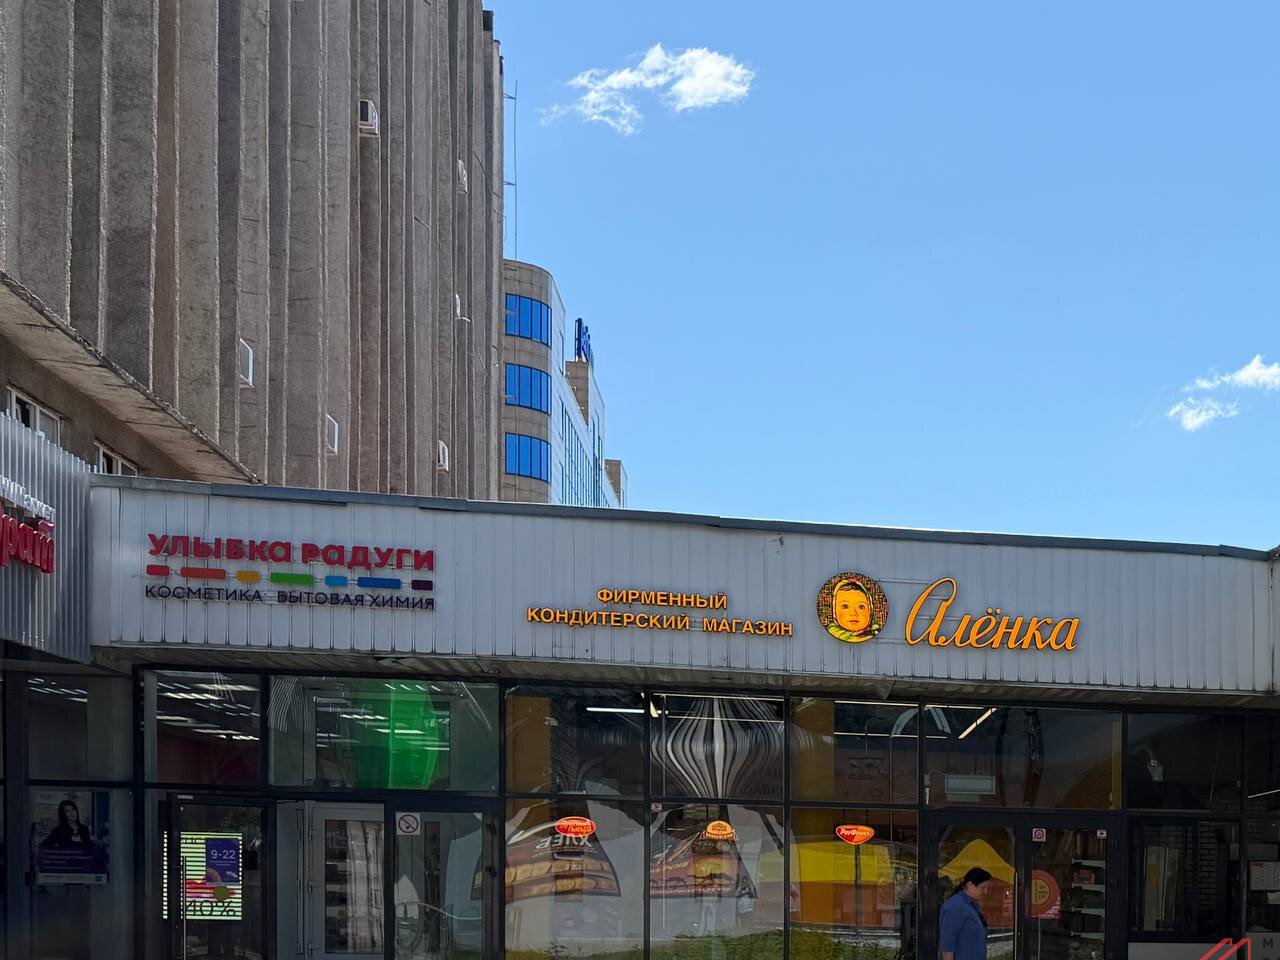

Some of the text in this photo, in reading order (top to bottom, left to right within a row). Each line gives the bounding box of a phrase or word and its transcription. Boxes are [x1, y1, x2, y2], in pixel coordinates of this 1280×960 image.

[145, 585, 435, 610] КОСМЕТИКА БЫТОВАЯ ХИМИЯ
[597, 588, 727, 609] ФИРМЕННЫЙ
[527, 607, 793, 636] КОНДИТЕРСКИЙ МАГАЗИН
[905, 577, 1081, 651] Алёнка
[210, 849, 236, 859] 9-22
